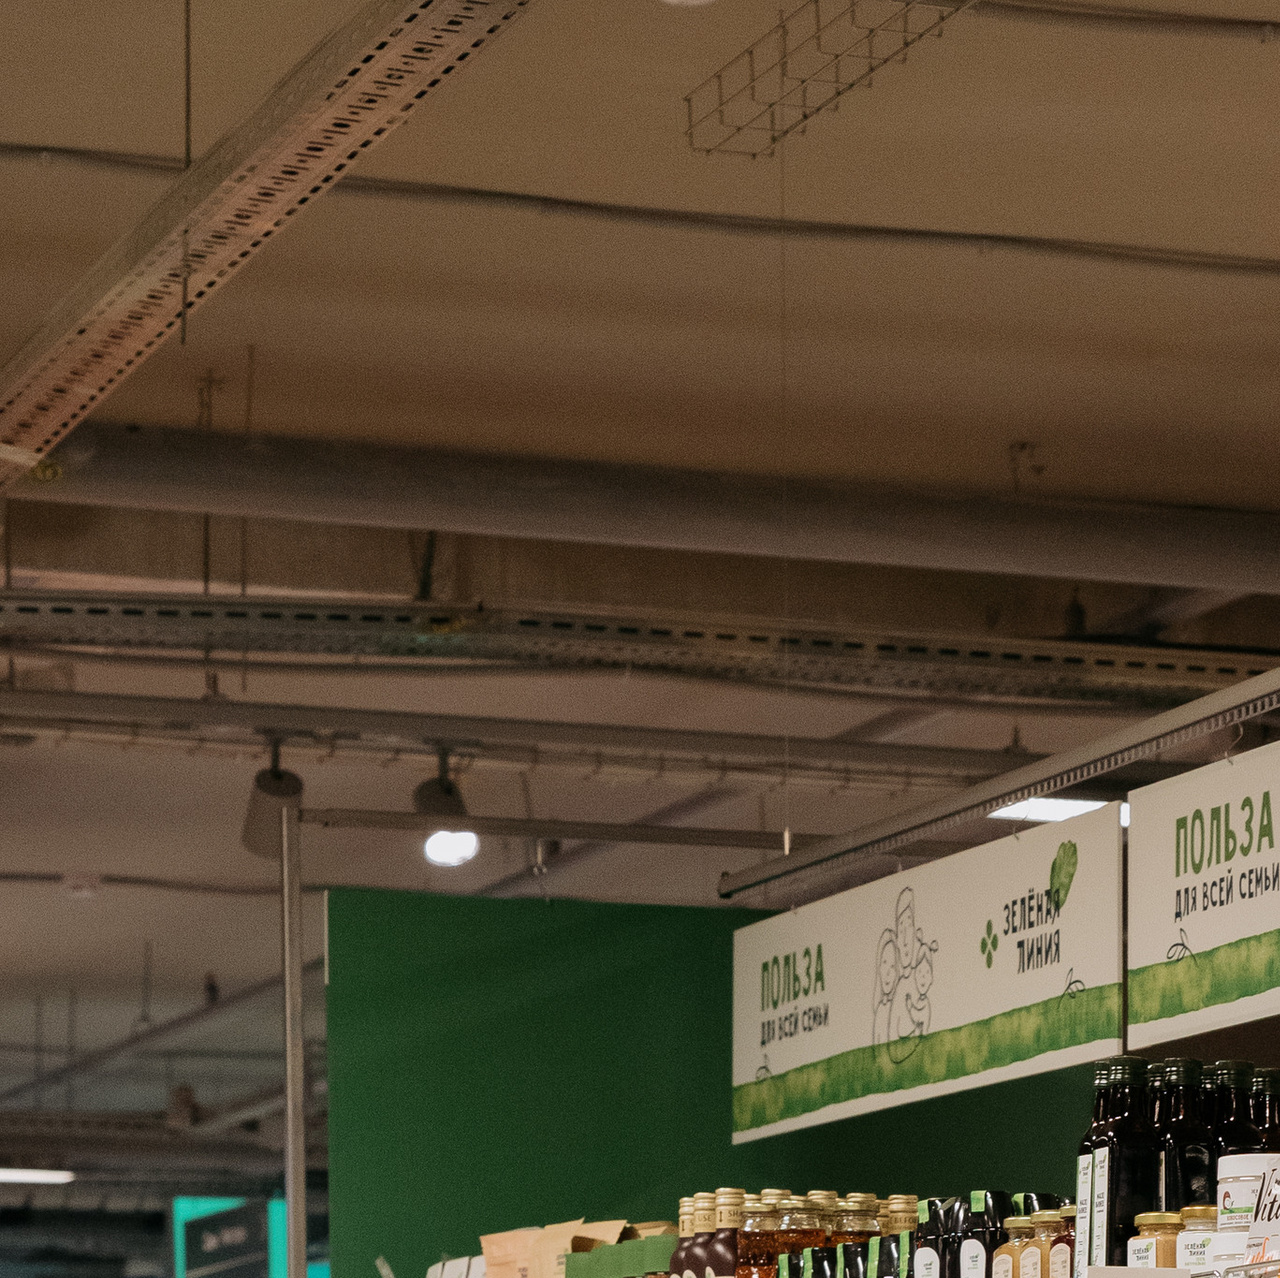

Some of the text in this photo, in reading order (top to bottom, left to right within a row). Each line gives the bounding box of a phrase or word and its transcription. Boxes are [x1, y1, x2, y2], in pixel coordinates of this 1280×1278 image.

[1175, 789, 1275, 878] ПОЛЬЗА
[1003, 889, 1061, 936] ЗЕЛЁНАЯ
[1174, 862, 1280, 923] ДЛЯ ВСЕЙ СЕМЬИ
[760, 943, 826, 1012] ПОЛЬЗА
[1017, 929, 1061, 975] ЛИНИЯ
[778, 1007, 799, 1038] ВСЕЙ
